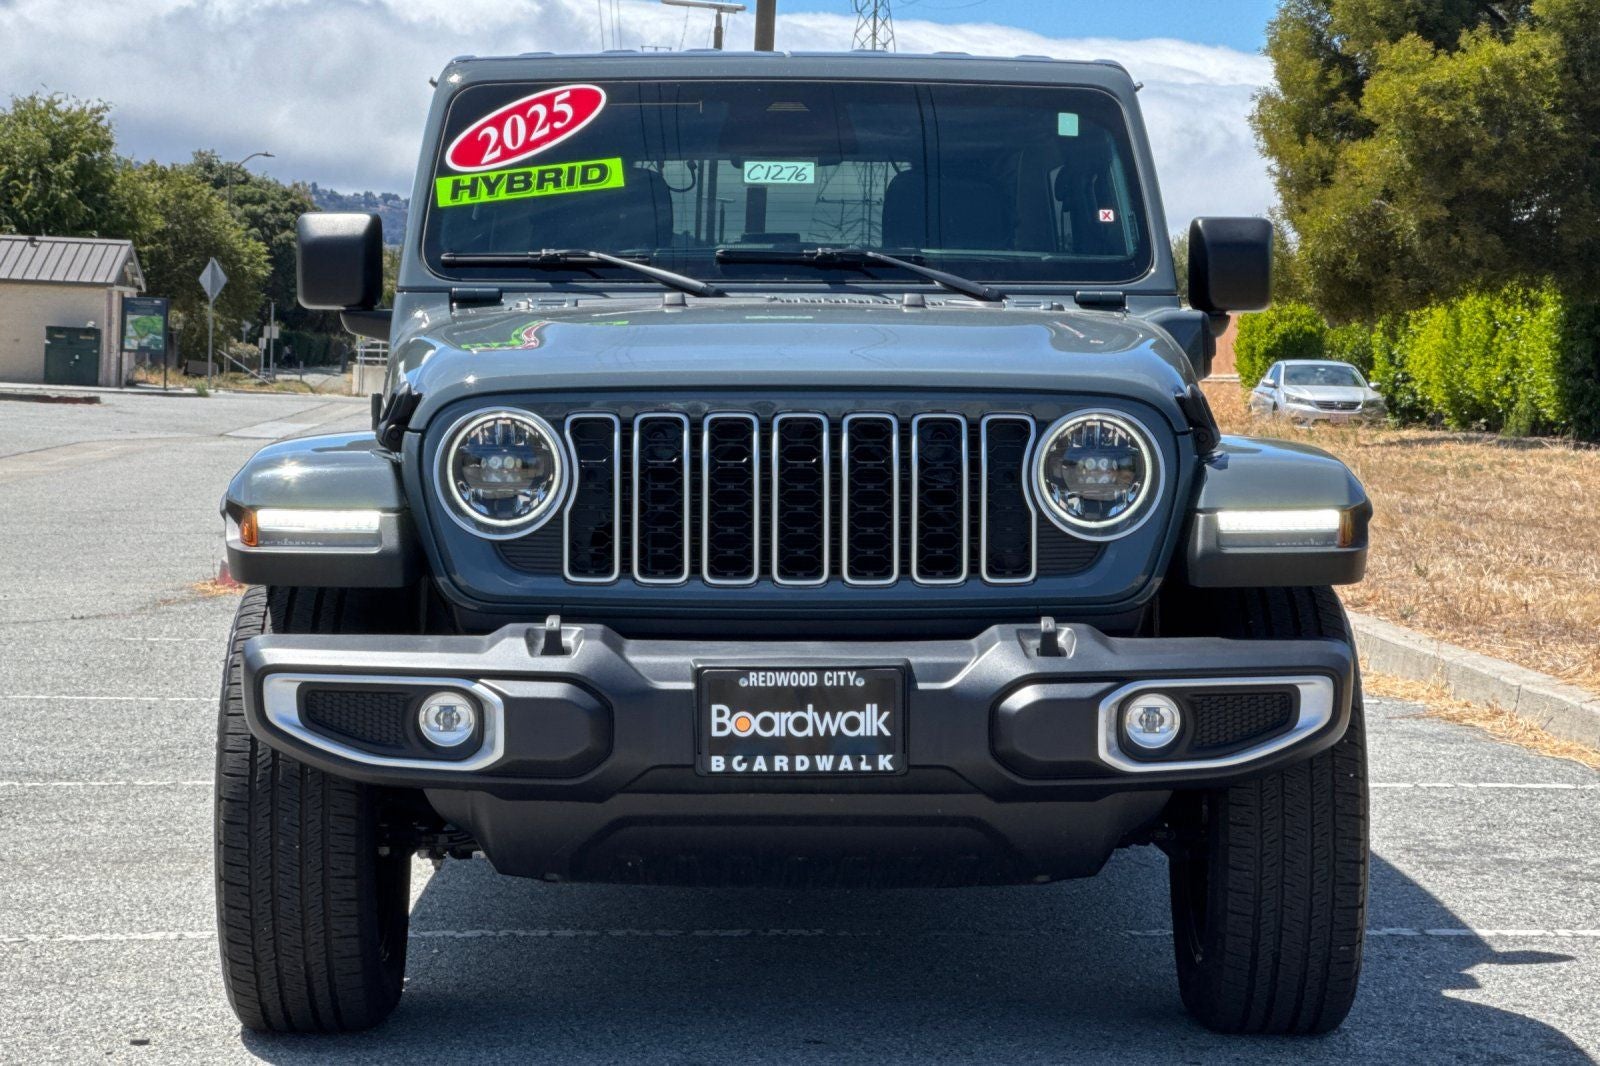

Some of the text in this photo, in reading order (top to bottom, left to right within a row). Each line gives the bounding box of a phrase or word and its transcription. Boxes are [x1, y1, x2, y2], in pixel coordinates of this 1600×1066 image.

[478, 91, 574, 164] 2025
[450, 161, 611, 201] HYBRID
[747, 163, 808, 183] C1276
[749, 671, 857, 687] REDWOOD CITY
[711, 703, 892, 737] Boardwalk
[711, 754, 894, 772] BOARDWALK
